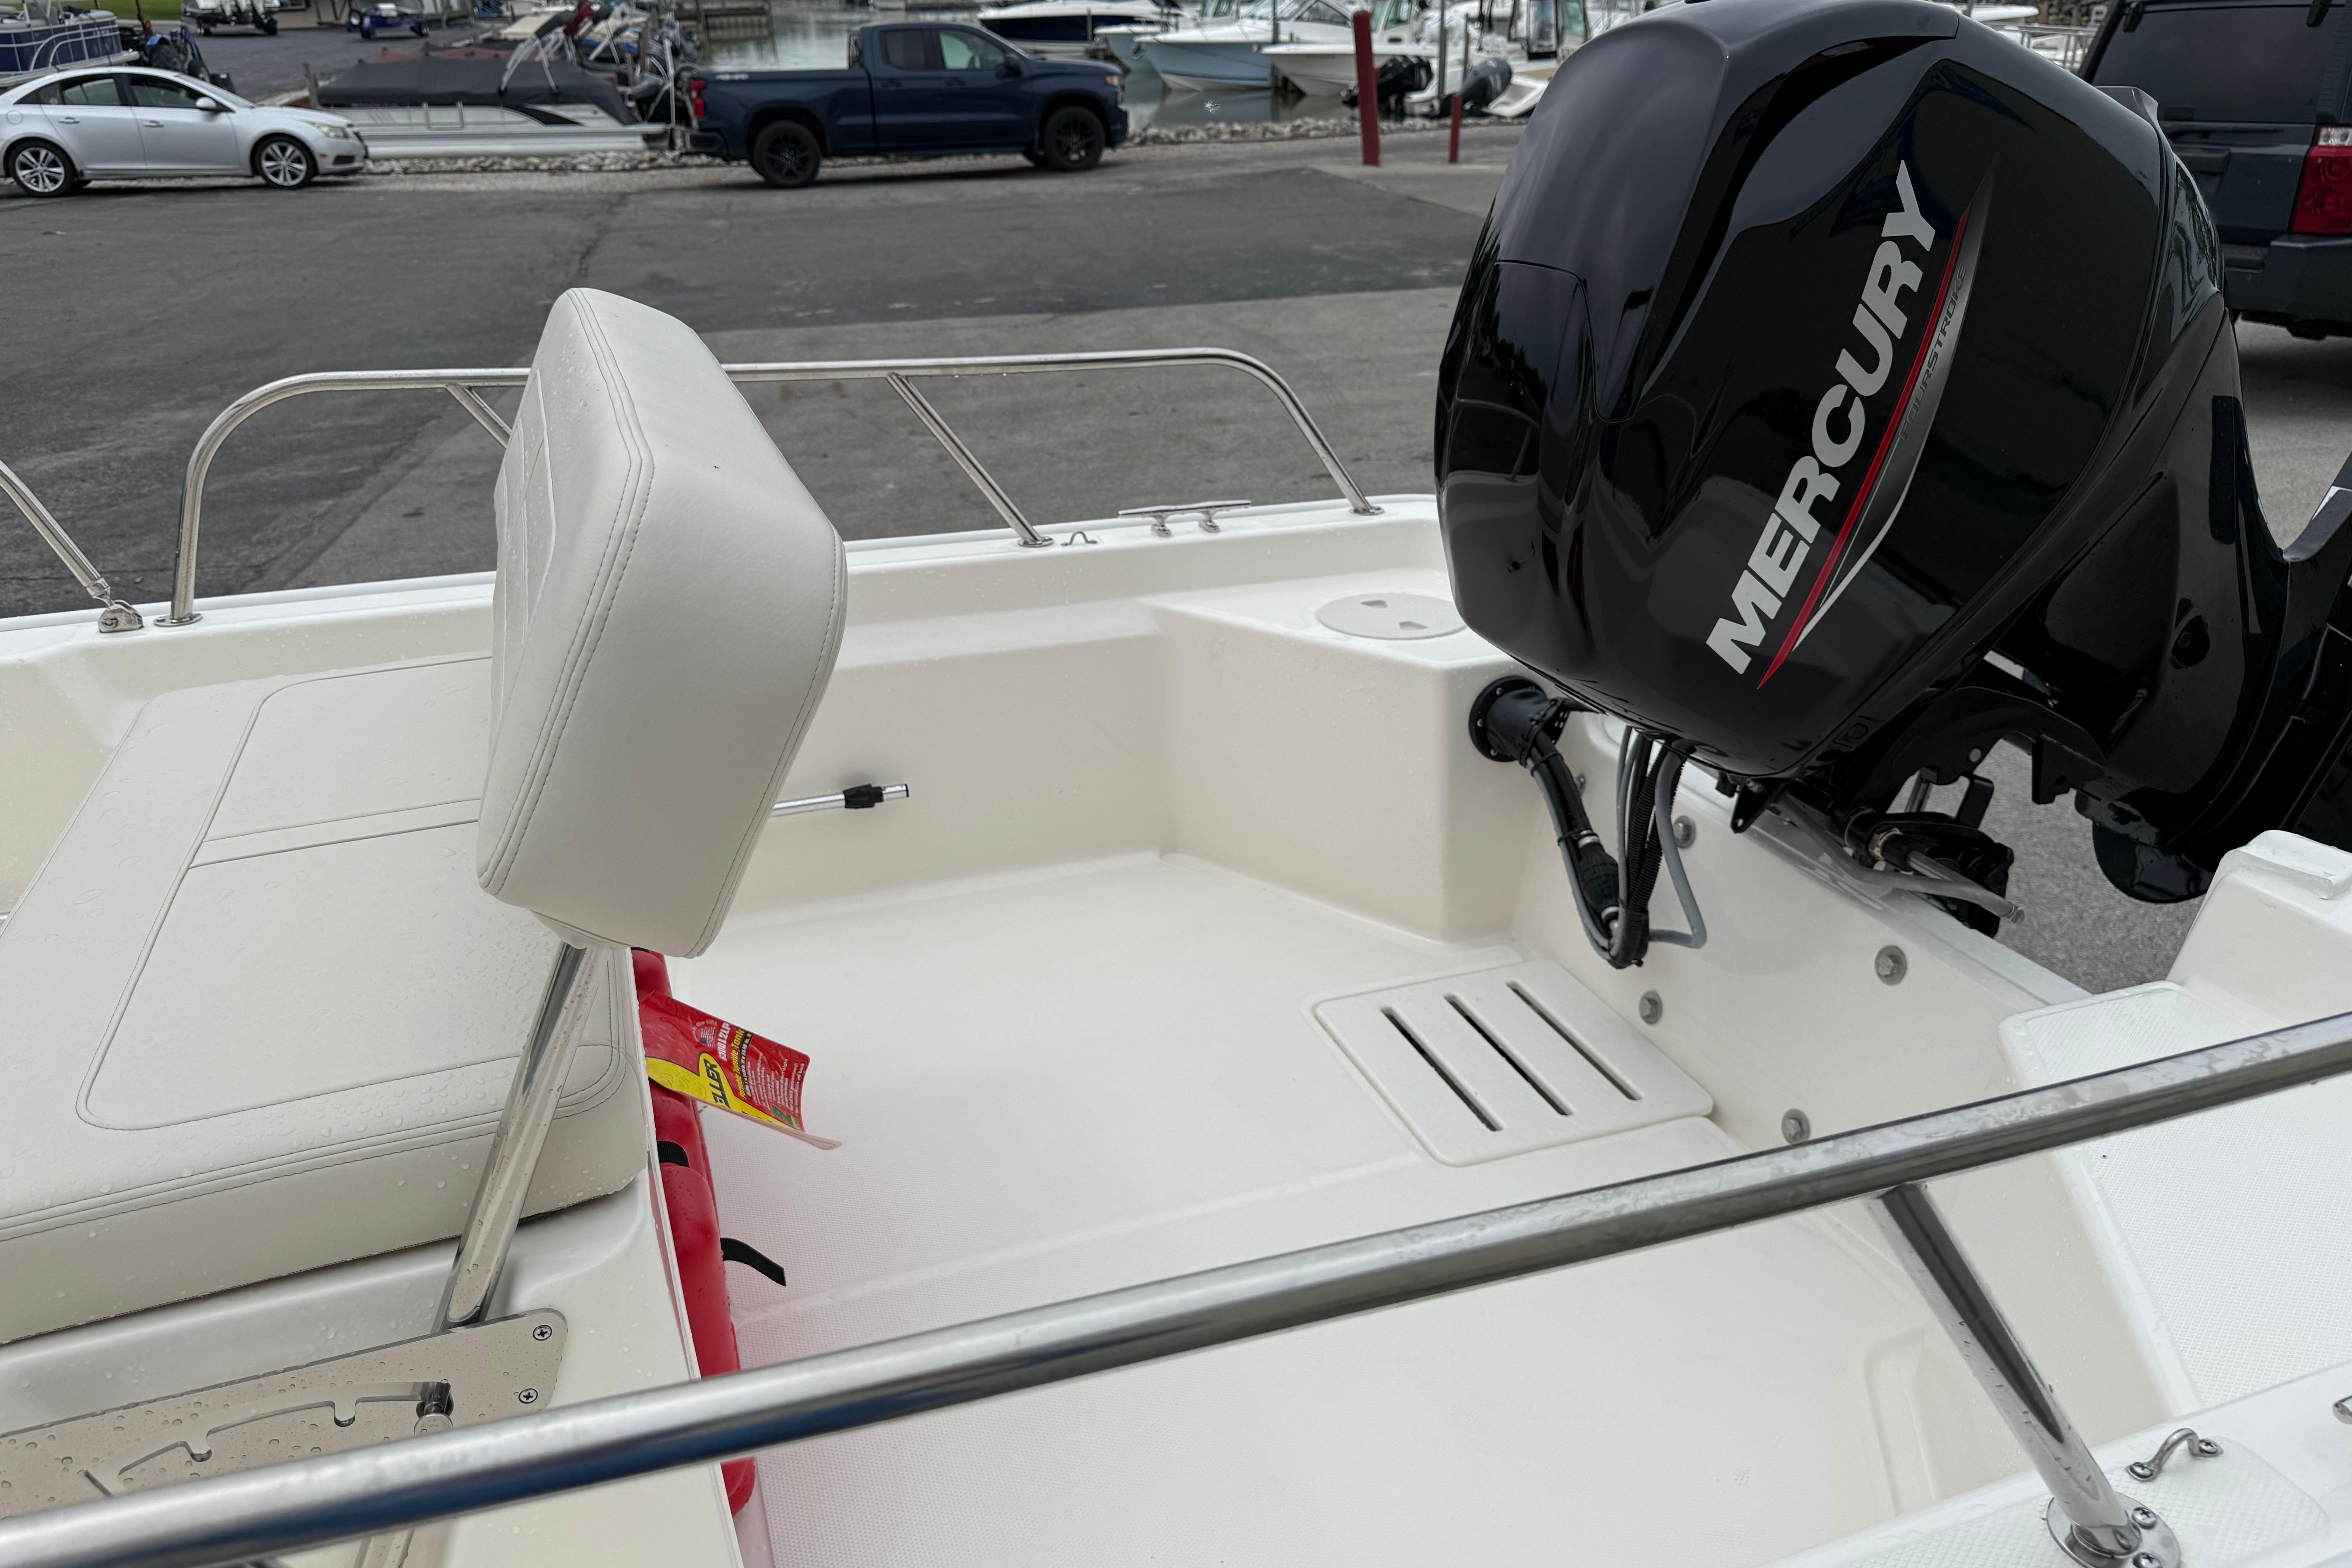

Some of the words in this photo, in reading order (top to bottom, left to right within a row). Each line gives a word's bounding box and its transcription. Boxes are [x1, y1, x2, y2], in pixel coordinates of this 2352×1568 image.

[1898, 264, 1967, 441] FOURSTROKE
[1706, 160, 1936, 674] MERCURY
[703, 1058, 731, 1109] ELLER
[731, 1029, 745, 1049] Tank
